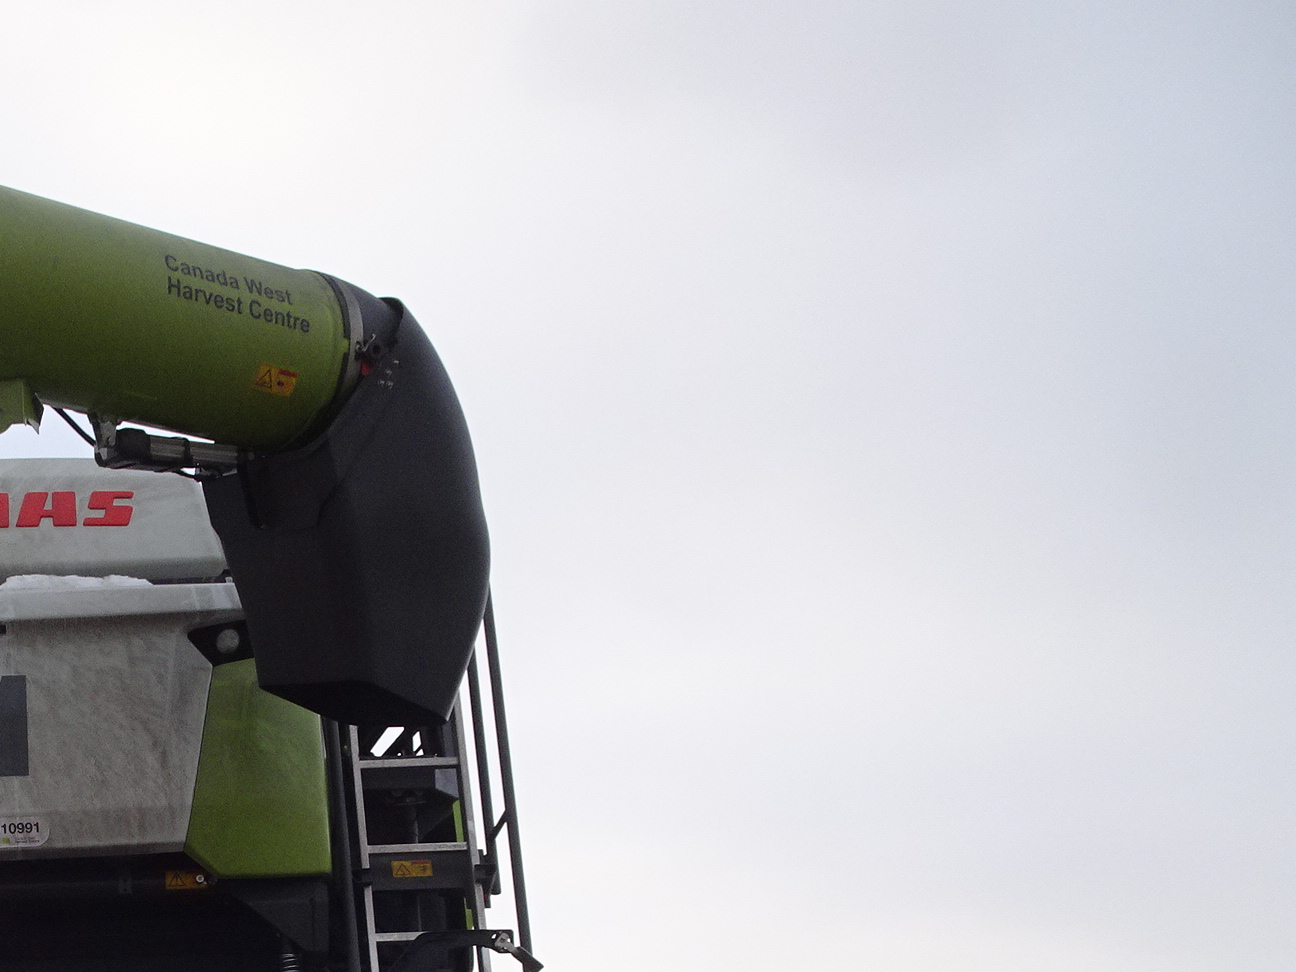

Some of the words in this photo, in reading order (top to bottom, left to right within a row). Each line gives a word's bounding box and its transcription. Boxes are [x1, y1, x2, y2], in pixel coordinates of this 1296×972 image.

[164, 254, 240, 290] Canada
[243, 276, 293, 305] West
[167, 276, 243, 314] Harvest
[248, 300, 310, 333] Centre
